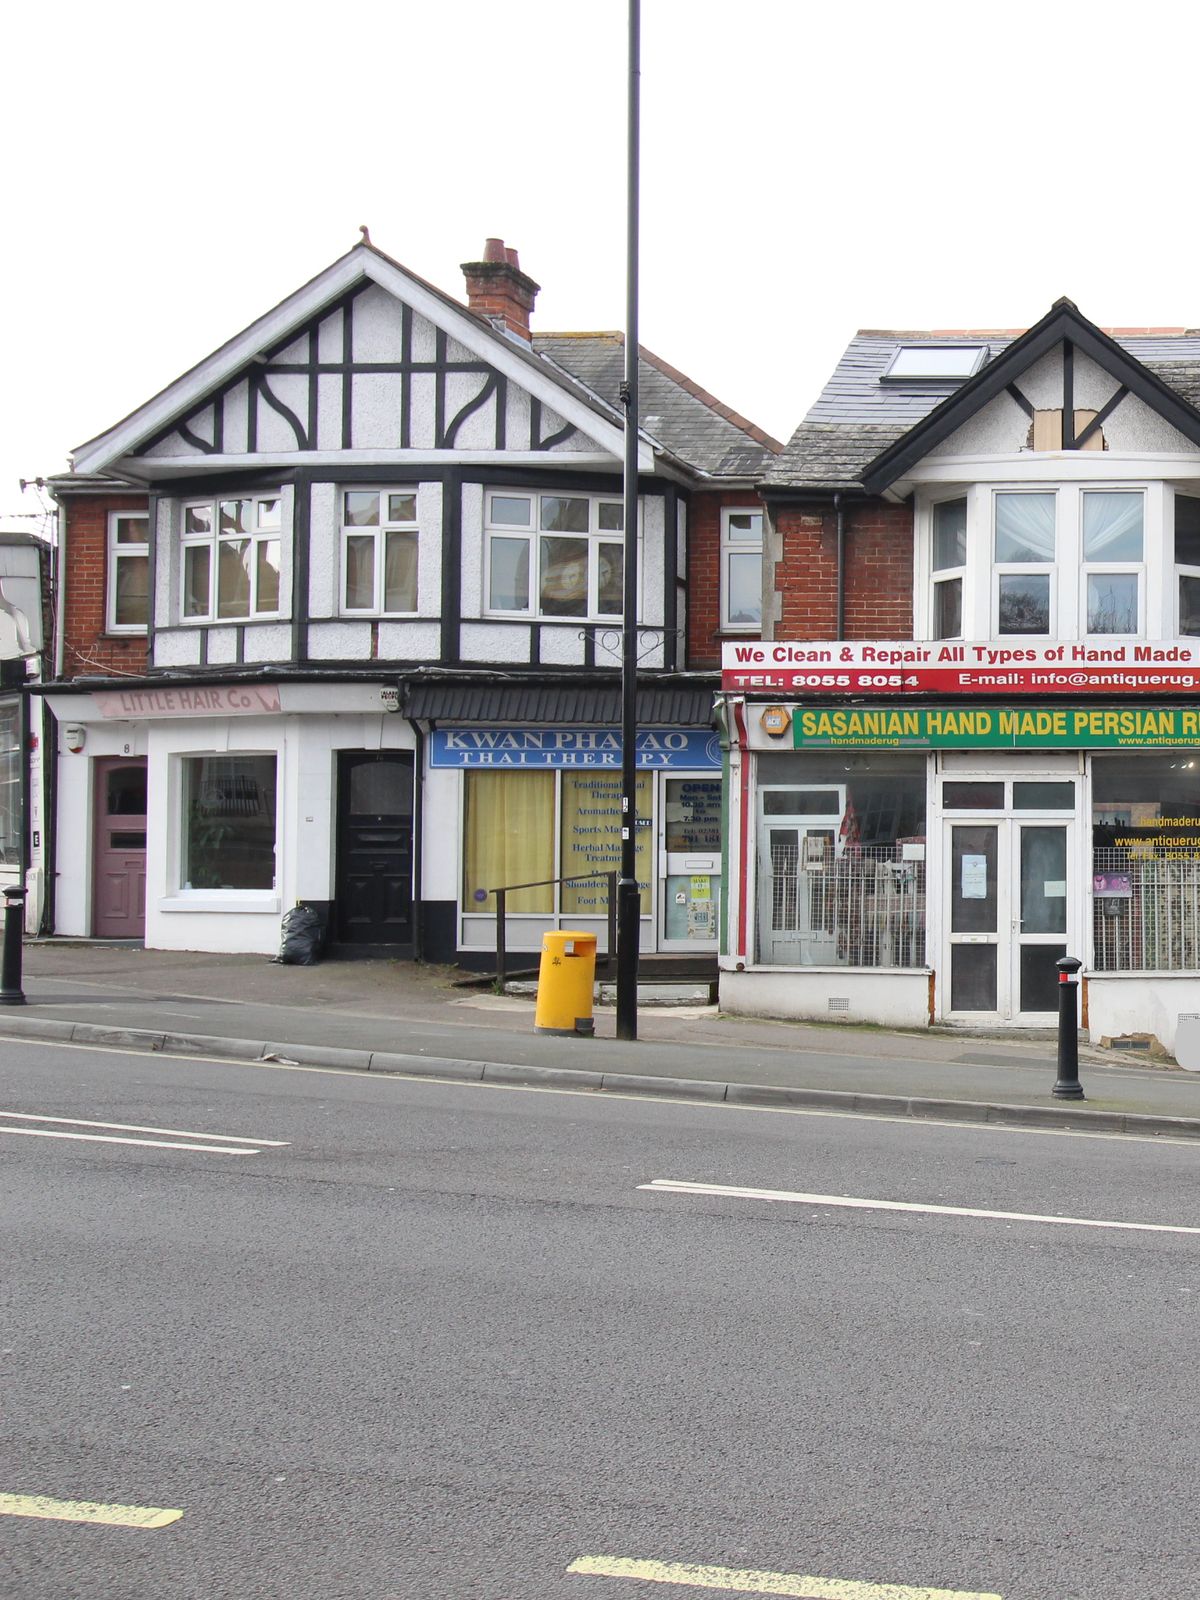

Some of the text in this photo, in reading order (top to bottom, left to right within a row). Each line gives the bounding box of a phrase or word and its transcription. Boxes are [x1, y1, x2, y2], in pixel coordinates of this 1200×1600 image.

[735, 646, 765, 662] We
[772, 646, 832, 662] Clean
[839, 646, 854, 662] &
[861, 646, 931, 665] Repair
[937, 646, 965, 662] All
[972, 646, 1037, 665] Types
[1043, 645, 1065, 661] of
[1071, 645, 1127, 661] Hand
[1134, 646, 1192, 662] Made
[734, 675, 784, 687] TEL:
[791, 675, 850, 687] 8055
[857, 675, 919, 687] 8054
[958, 673, 1025, 686] E-mail:
[120, 689, 251, 712] LITTLE HAIR Co
[802, 711, 919, 736] SASANIAN
[926, 711, 992, 736] HAND
[999, 711, 1067, 735] MADE
[1074, 711, 1174, 735] PERSIAN
[445, 732, 689, 750] KWAN PHAAO
[830, 736, 900, 747] handmaderug
[123, 743, 130, 754] 8
[460, 752, 674, 765] THAI THERPY
[572, 780, 624, 789] Traditional
[682, 783, 721, 793] OPEN
[592, 791, 625, 800] Therap
[573, 825, 602, 835] Sports
[572, 843, 603, 852] Herbal
[585, 853, 623, 862] Treatme
[577, 896, 597, 905] Foot
